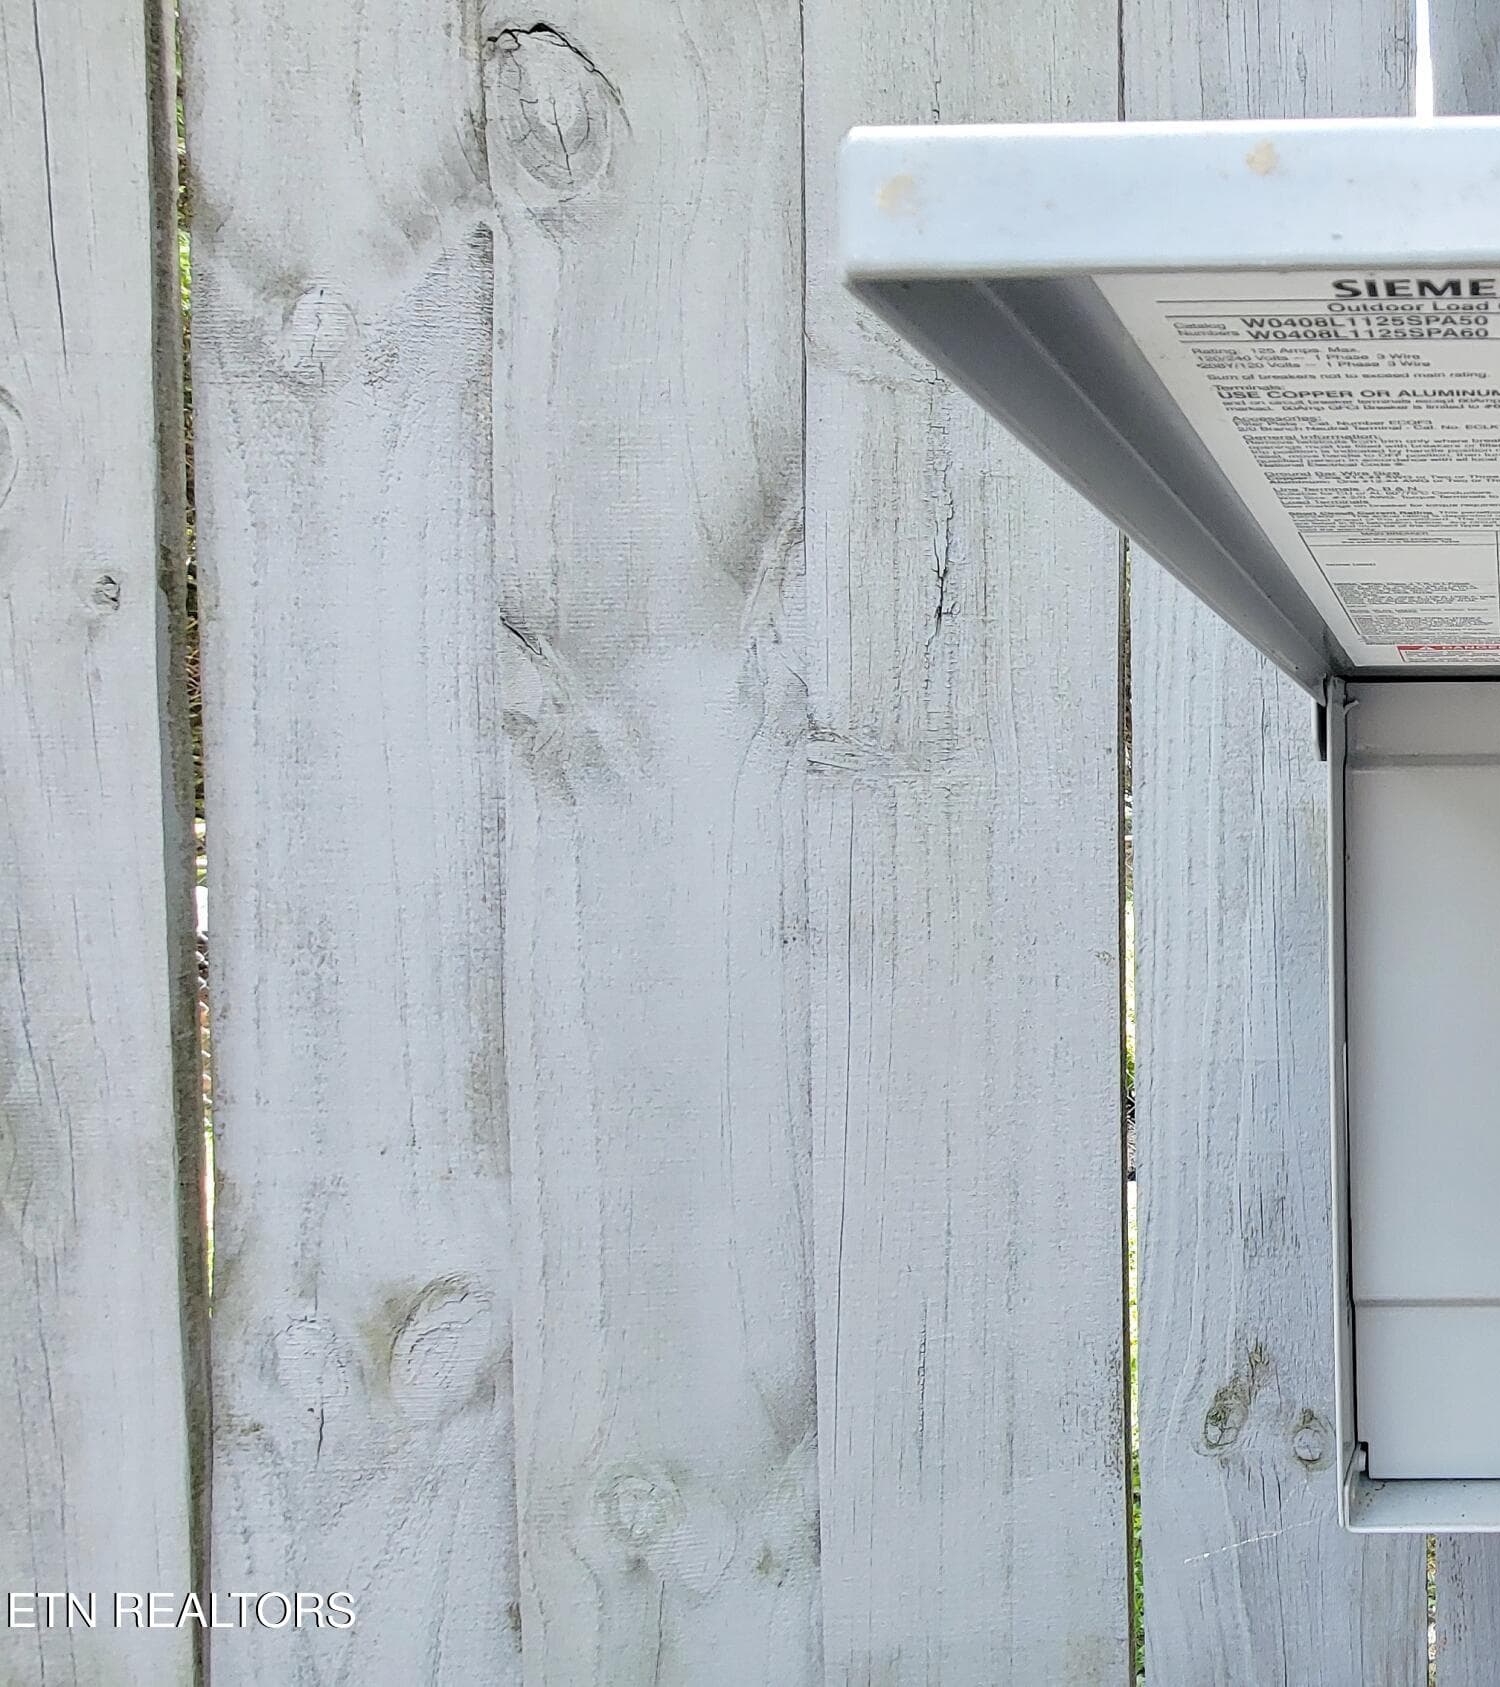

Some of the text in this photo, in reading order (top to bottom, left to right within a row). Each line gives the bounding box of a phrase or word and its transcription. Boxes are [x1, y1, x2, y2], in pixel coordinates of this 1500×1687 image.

[1327, 302, 1424, 312] Outdoor
[1432, 301, 1489, 312] Load
[1240, 315, 1489, 328] W0408L1125SPA50
[1246, 328, 1489, 340] W0408L1125SPA60
[1217, 390, 1261, 399] USE
[1266, 390, 1353, 399] COPPER
[1359, 389, 1391, 398] OR
